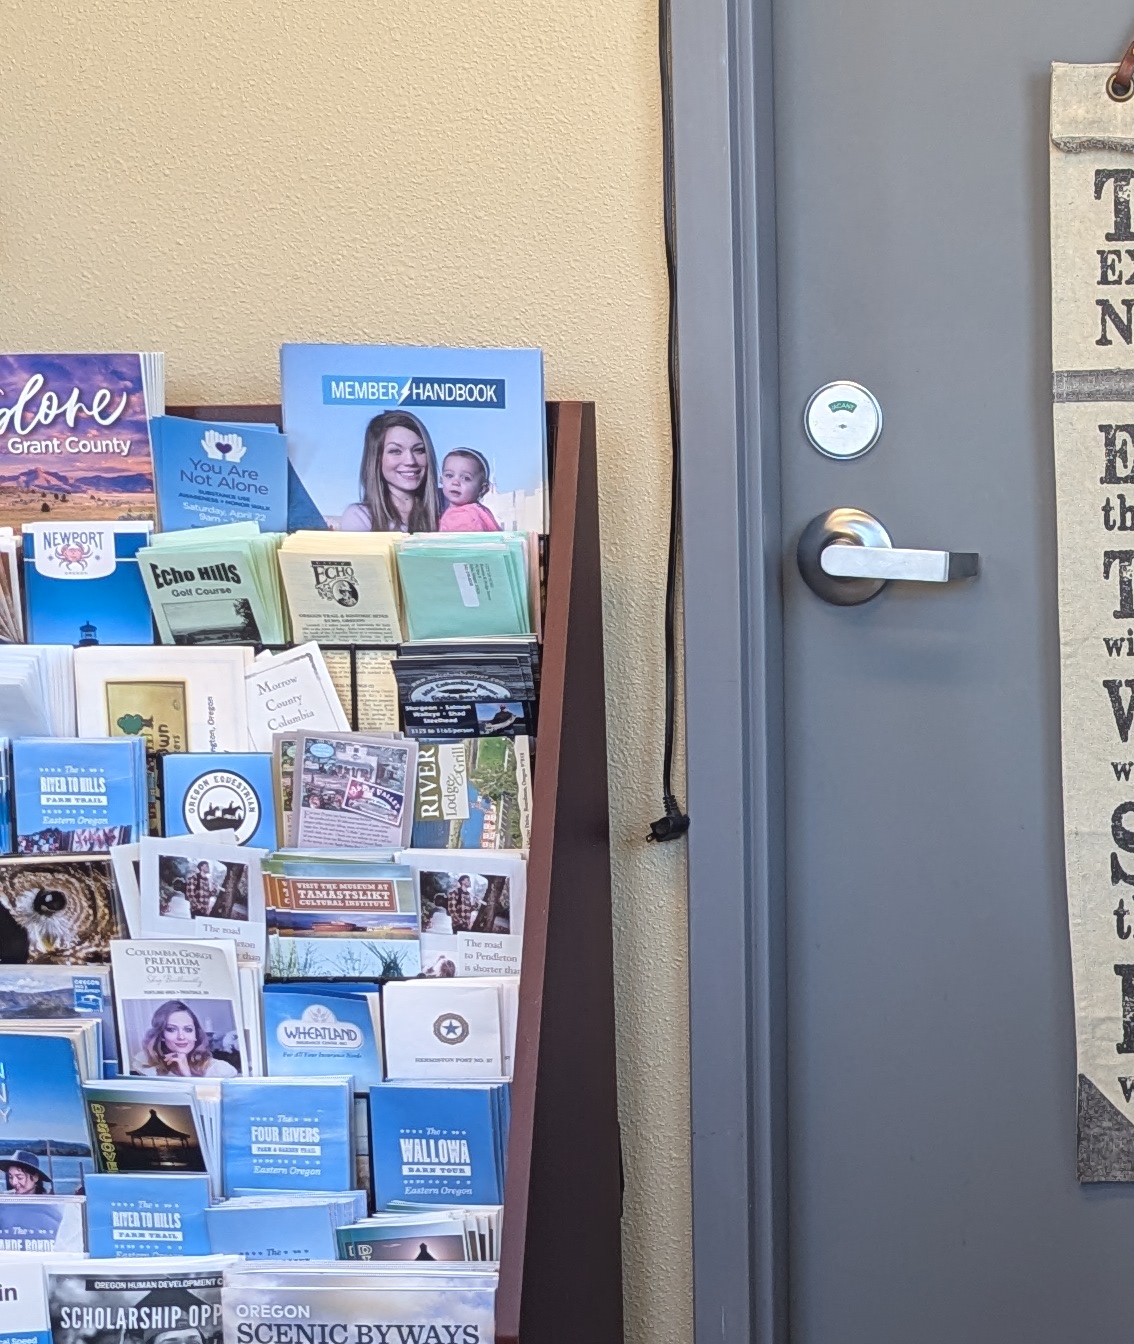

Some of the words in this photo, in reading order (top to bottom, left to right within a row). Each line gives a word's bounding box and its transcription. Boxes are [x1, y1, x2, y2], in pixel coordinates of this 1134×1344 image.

[331, 380, 398, 400] MEMBER
[412, 383, 498, 403] HANDBOOK
[7, 437, 61, 454] Grant
[65, 437, 132, 456] County
[190, 457, 222, 474] You
[228, 464, 258, 480] Are
[180, 470, 212, 486] Not
[217, 476, 268, 495] Alone
[230, 510, 252, 518] April
[254, 514, 266, 522] 22
[43, 532, 104, 550] NEWPORT
[150, 562, 195, 590] Echo
[198, 562, 242, 585] Hills
[311, 566, 354, 586] ECHO
[171, 588, 193, 598] Golf
[195, 586, 232, 596] Course
[256, 676, 298, 696] Morrow
[208, 696, 216, 726] Oregon
[266, 694, 302, 712] County
[267, 709, 314, 730] Columbia
[41, 777, 67, 792] RIVER
[67, 777, 79, 792] TO
[80, 777, 106, 793] HILLS
[418, 747, 440, 818] RIVER
[444, 780, 458, 816] Lodge
[452, 746, 464, 774] Grill
[43, 816, 75, 824] Eastern
[77, 816, 108, 826] Oregon
[203, 924, 220, 933] The
[464, 939, 482, 948] The
[484, 941, 502, 949] road
[125, 948, 177, 957] COLUMBIA
[476, 952, 517, 962] Pendleton
[144, 957, 200, 966] PREMIUM
[473, 963, 502, 973] shorter
[284, 1026, 357, 1041] WHEATLAND
[252, 1126, 279, 1141] FOUR
[282, 1127, 320, 1142] RIVERS
[400, 1138, 470, 1163] WALLOWA
[254, 1166, 287, 1174] Eastern
[290, 1167, 320, 1176] Oregon
[441, 1187, 472, 1196] Oregon
[113, 1211, 140, 1227] RIVER
[141, 1212, 152, 1227] TO
[154, 1213, 181, 1228] HILLS
[267, 1248, 281, 1256] The
[94, 1281, 126, 1289] OREGON
[128, 1281, 157, 1289] HUMAN
[158, 1278, 215, 1288] DEVELOPMENT
[60, 1306, 181, 1329] SCHOLARSHIP
[188, 1304, 222, 1327] OPP
[236, 1305, 310, 1319] OREGON
